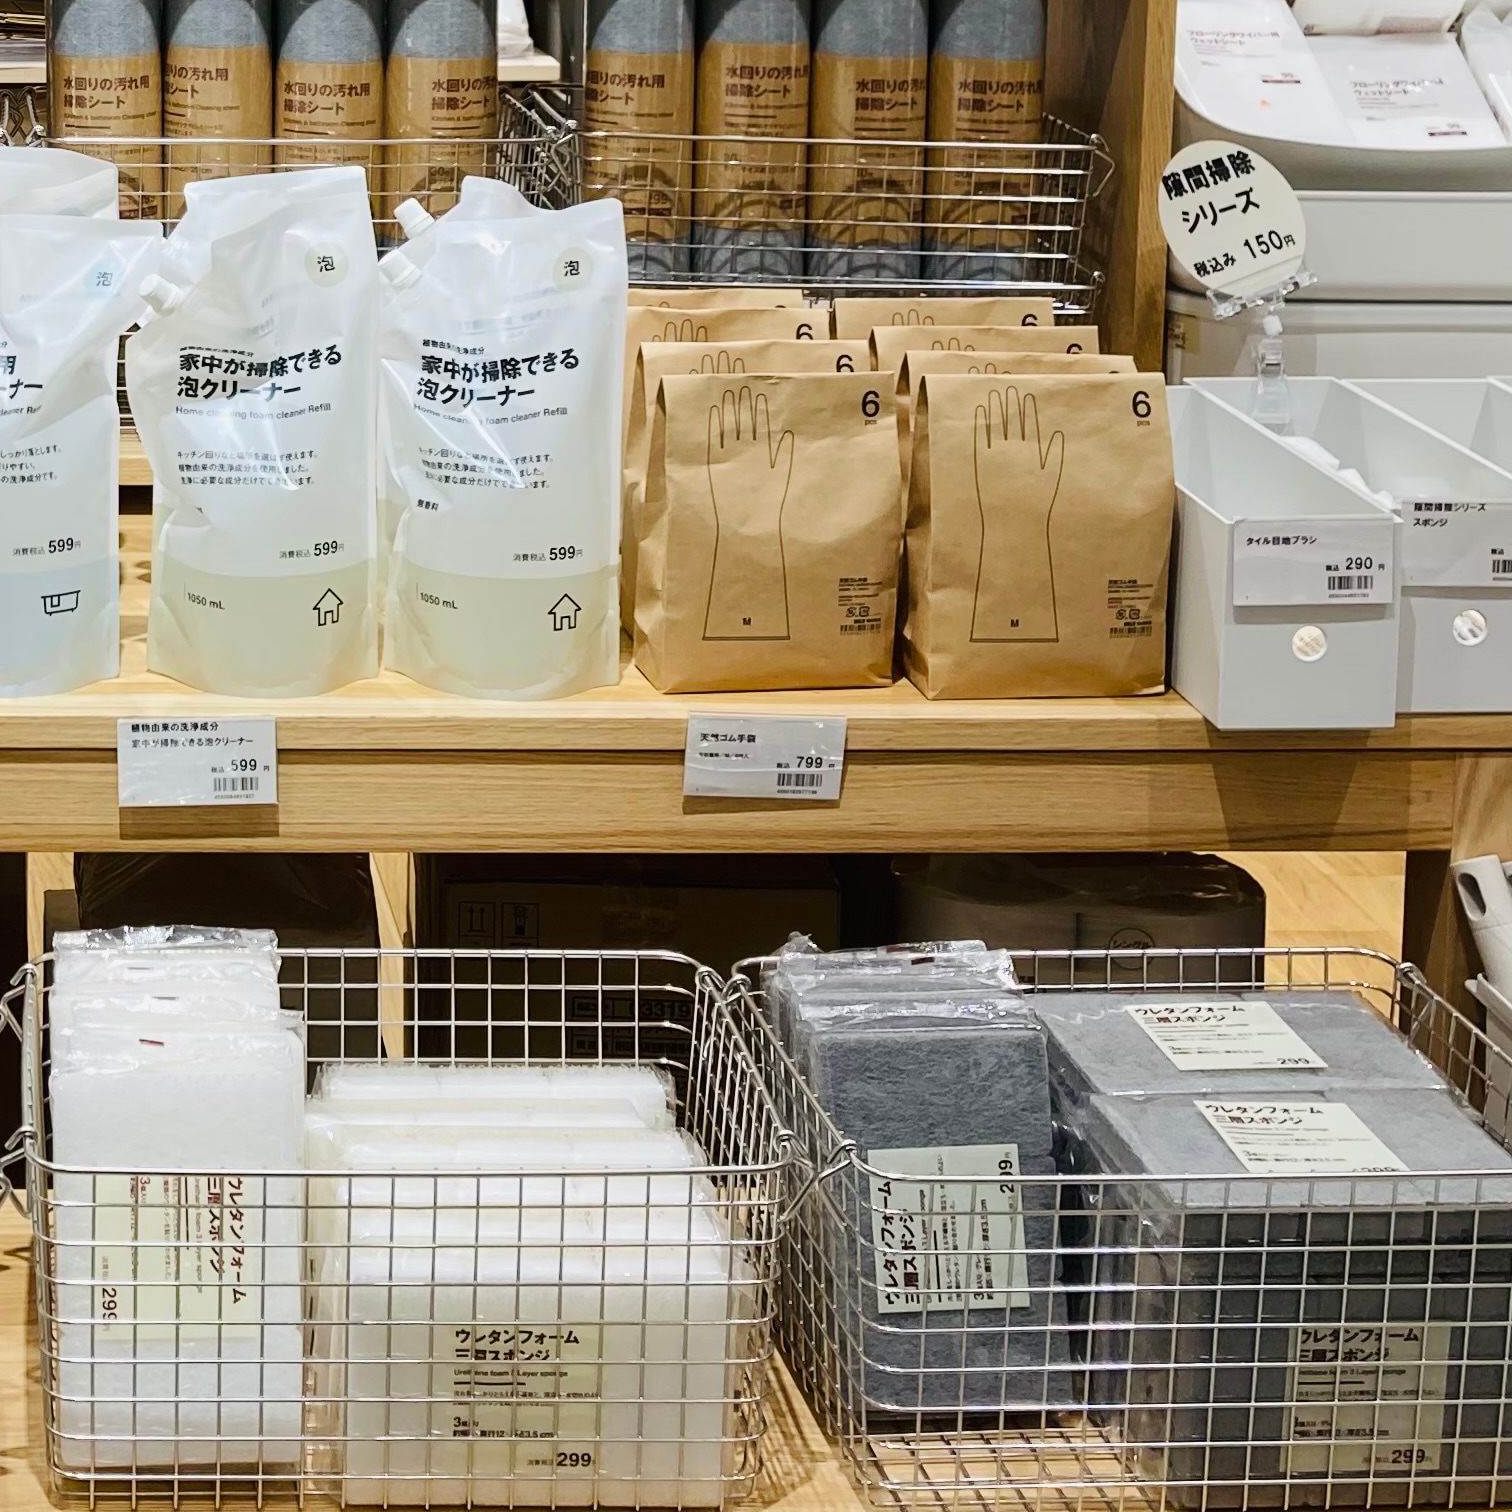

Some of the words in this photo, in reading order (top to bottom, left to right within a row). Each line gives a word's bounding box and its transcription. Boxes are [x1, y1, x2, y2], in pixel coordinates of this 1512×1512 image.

[64, 75, 149, 91] 水回りの汚れ用
[284, 81, 370, 98] 水回りの汚れ用
[726, 84, 791, 98] 掃除シート
[64, 94, 125, 109] 掃除シート
[284, 99, 344, 116] 掃除シート
[856, 96, 917, 111] 掃除シート
[958, 98, 1024, 113] 掃除シート
[1162, 151, 1256, 200] 隙間掃除
[1182, 188, 1260, 233] シリーズ
[317, 256, 335, 272] 泡
[564, 261, 580, 277] 泡
[1194, 253, 1236, 278] 税込み
[96, 271, 113, 287] 泡
[180, 344, 342, 377] 家中が掃除できる
[421, 348, 579, 383] 家中が掃除できる
[178, 376, 301, 402] 泡クリーナー
[418, 377, 535, 406] 泡クリーナー
[176, 406, 203, 416] Home
[277, 407, 306, 420] cleaner
[308, 403, 331, 413] Refill
[861, 391, 880, 418] 6
[1132, 391, 1152, 418] 6
[511, 410, 541, 423] cleaner
[544, 407, 568, 416] Refill
[417, 499, 438, 511] 無香料
[1413, 518, 1448, 527] スポンジ
[1246, 535, 1317, 546] タイル目地ブラシ
[513, 553, 546, 562] 消費税込
[1346, 557, 1373, 570] 290
[188, 593, 206, 606] 1050
[210, 599, 225, 610] mL
[420, 593, 440, 606] 1050
[443, 599, 458, 609] mL
[743, 617, 751, 626] M
[1011, 619, 1019, 627] M
[132, 722, 219, 732] 植物由来の洗浄成分
[132, 737, 253, 748] 家中が掃除できる泡クリーナー
[232, 759, 257, 772] 599
[797, 756, 823, 768] 799
[1135, 1005, 1245, 1015] ウレタンフォーム
[1206, 1105, 1323, 1115] ウレタンフォーム
[878, 1181, 899, 1305] ウレタンフォーム
